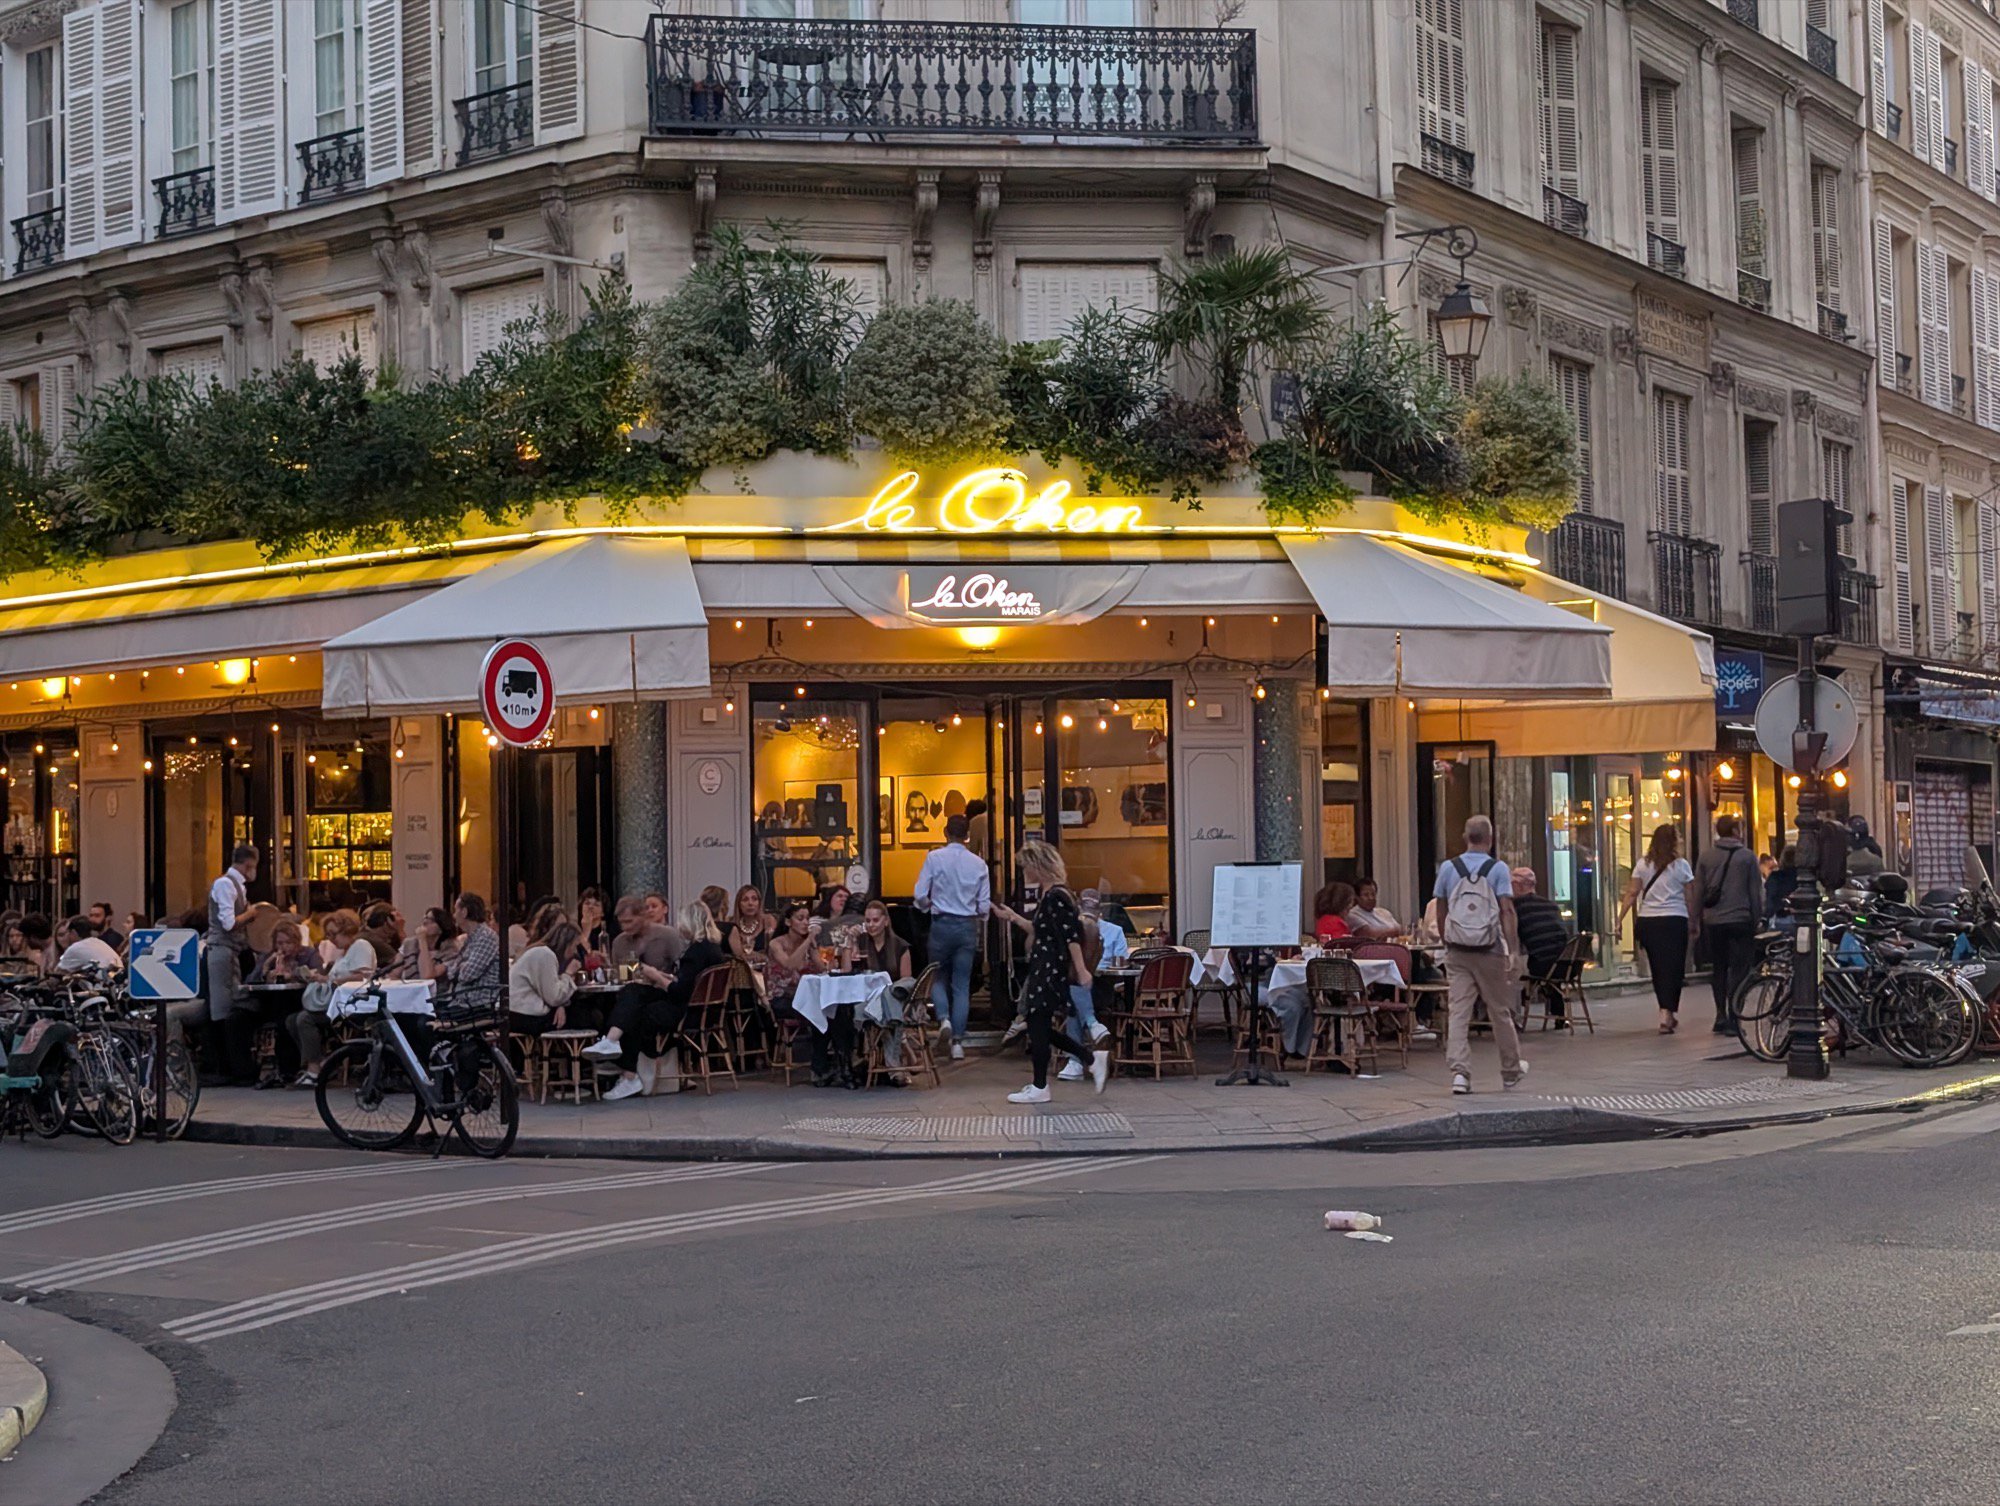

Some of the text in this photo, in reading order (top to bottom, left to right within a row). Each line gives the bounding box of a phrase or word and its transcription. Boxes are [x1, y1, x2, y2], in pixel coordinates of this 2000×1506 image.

[828, 470, 932, 533] le
[912, 575, 961, 607] le
[1001, 607, 1041, 616] MARAIS
[1719, 674, 1760, 690] FORÊT
[510, 704, 530, 716] 10m
